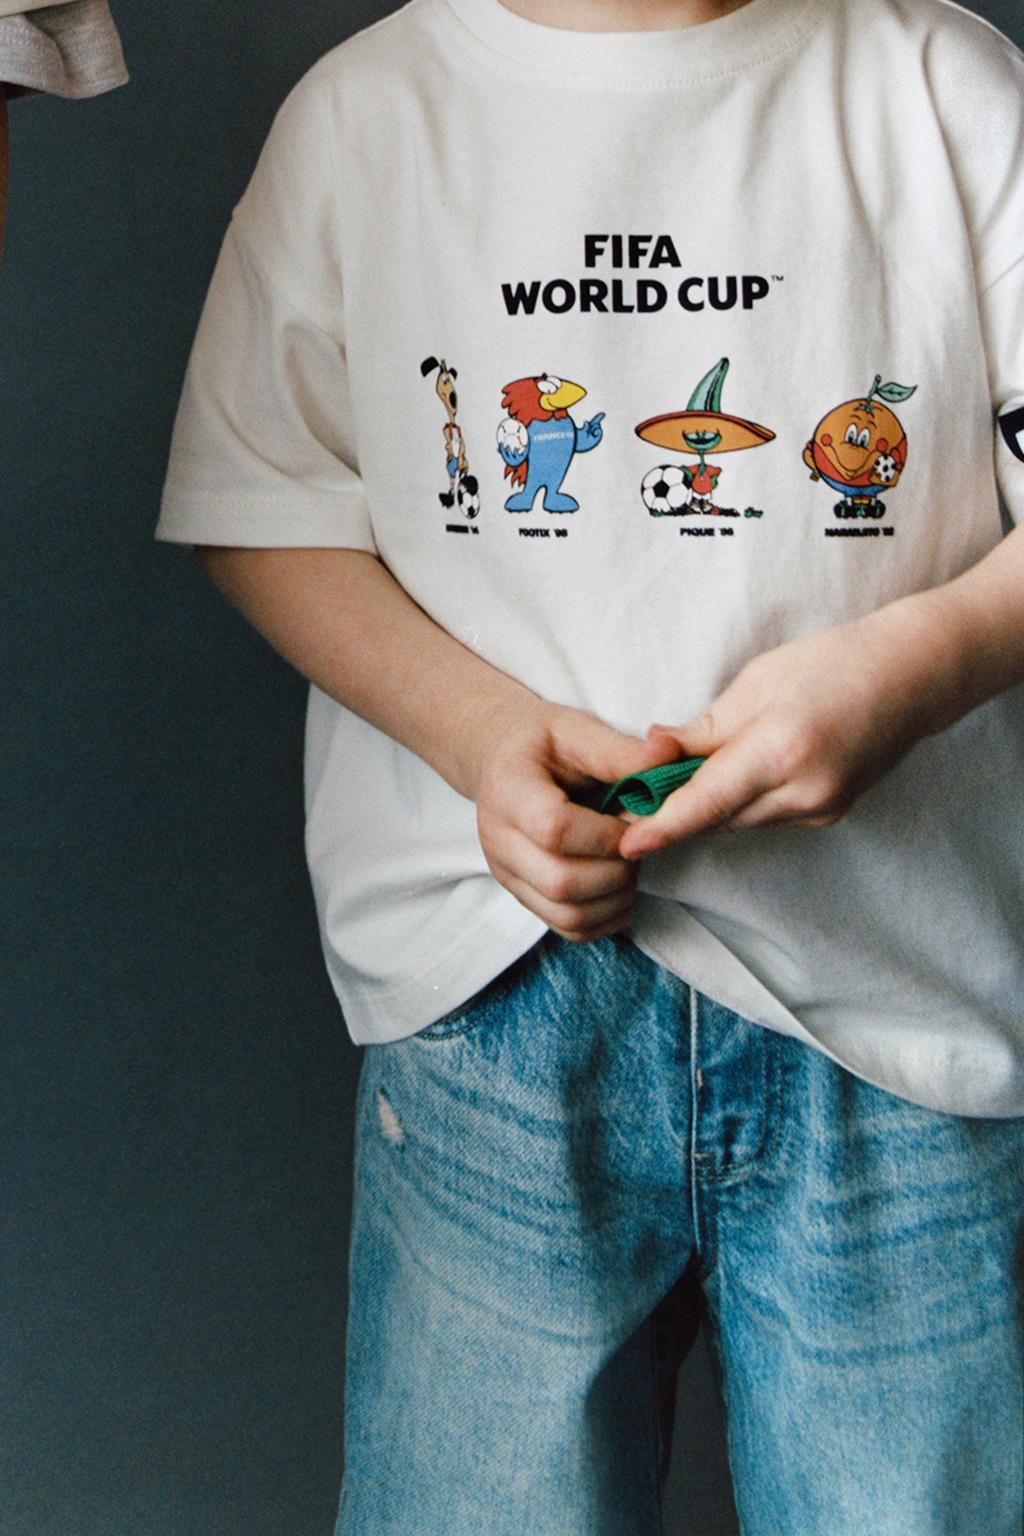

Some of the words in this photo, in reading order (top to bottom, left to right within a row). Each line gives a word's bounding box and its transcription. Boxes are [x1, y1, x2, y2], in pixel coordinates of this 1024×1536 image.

[584, 234, 682, 268] FIFA
[501, 278, 668, 315] WORLD
[679, 527, 715, 537] PIQUE
